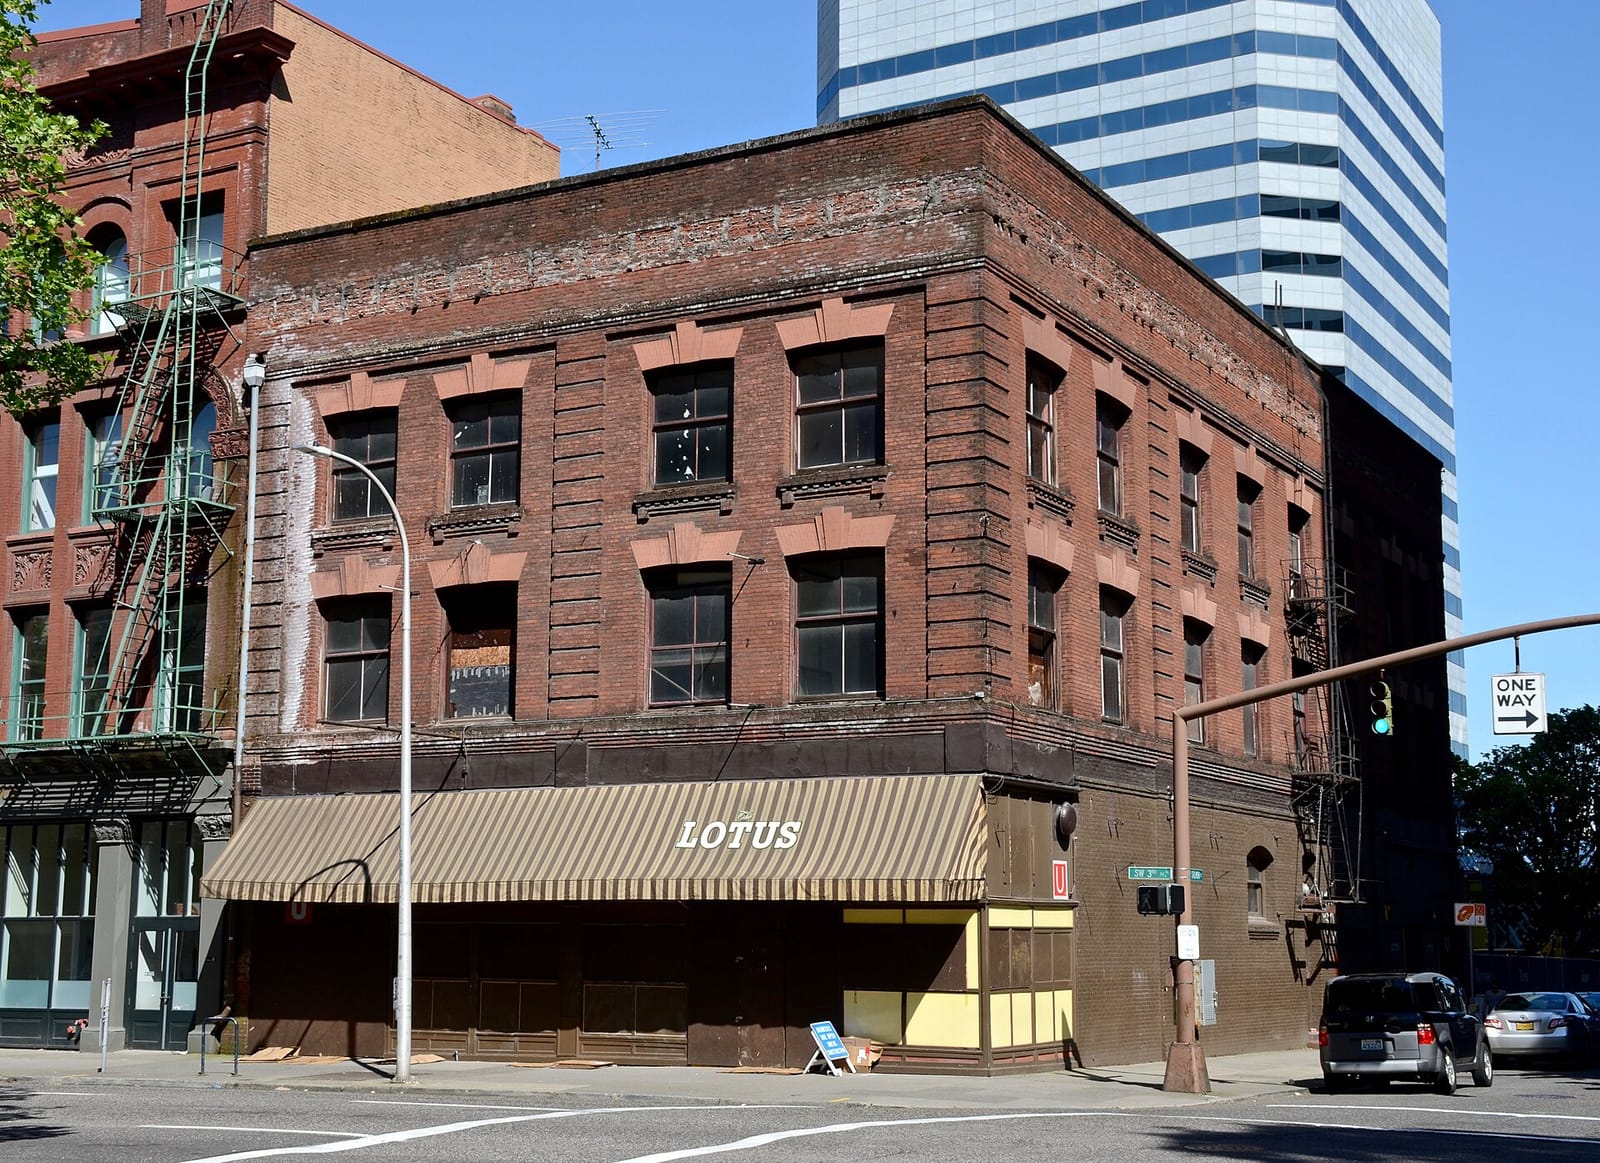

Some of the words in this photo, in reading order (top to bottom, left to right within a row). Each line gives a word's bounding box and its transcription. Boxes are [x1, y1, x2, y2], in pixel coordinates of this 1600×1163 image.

[1497, 679, 1536, 691] ONE
[1497, 694, 1536, 707] WAY
[675, 821, 802, 849] LOTUS
[1055, 866, 1065, 893] U
